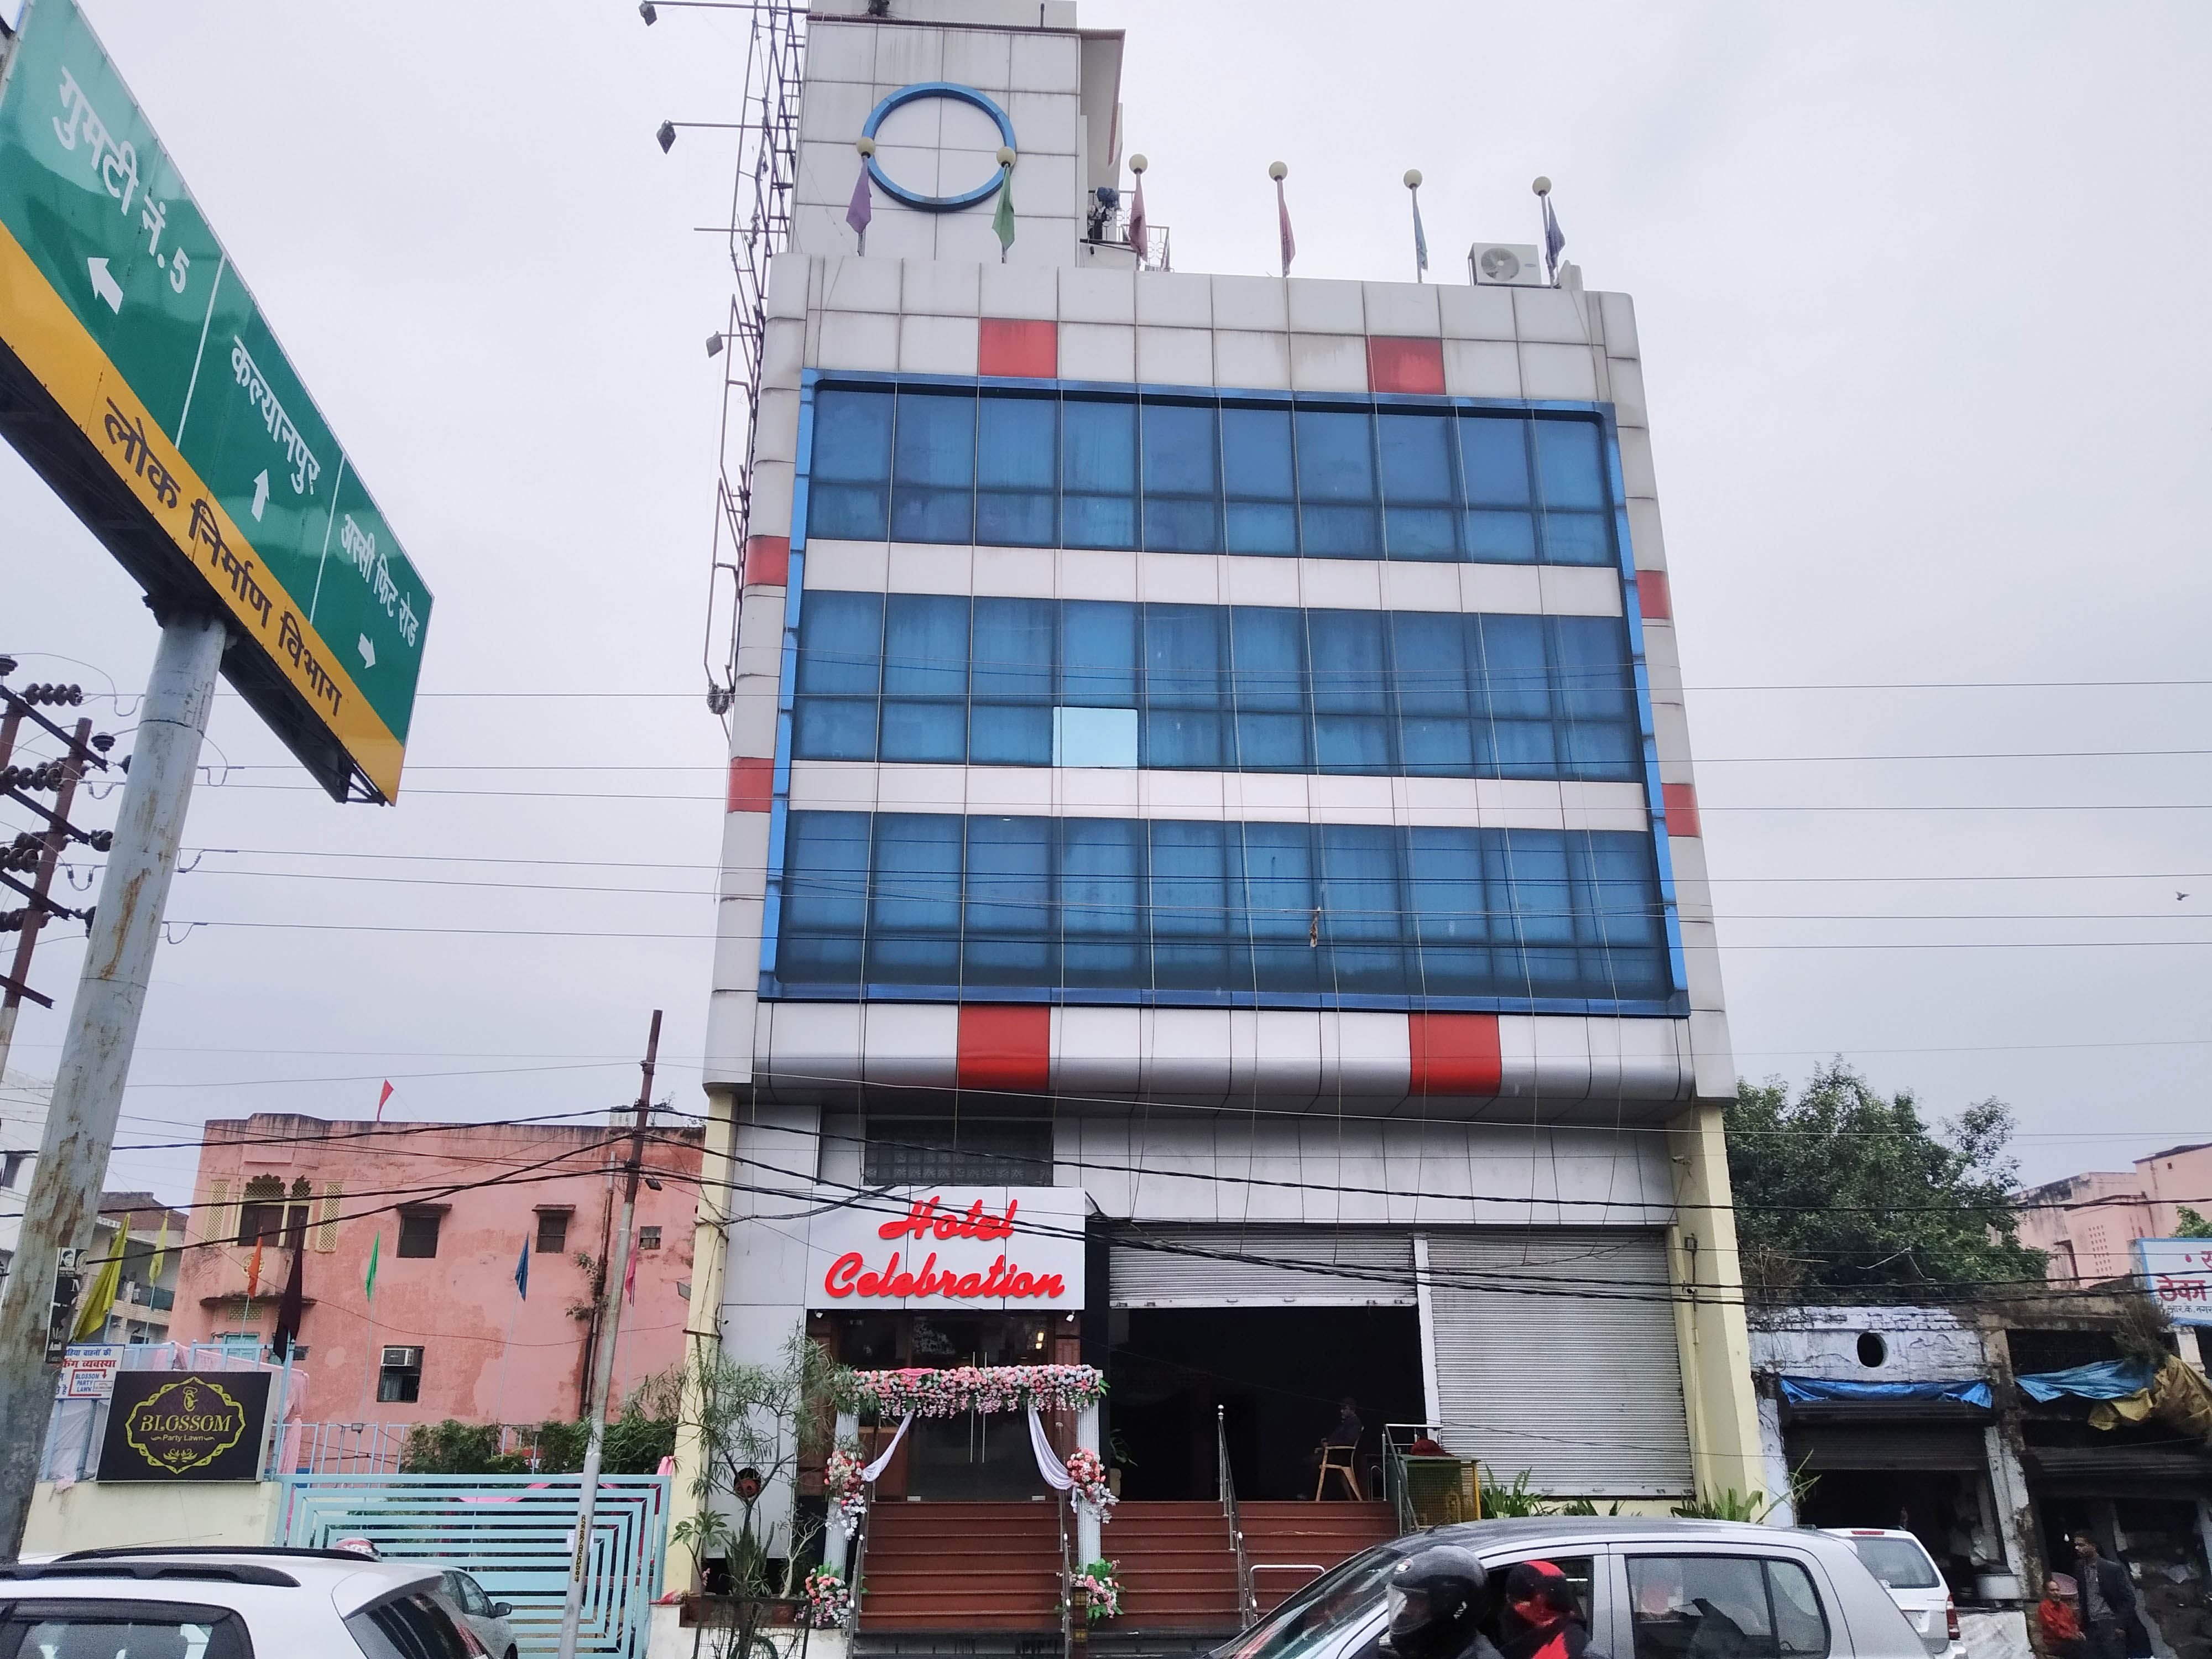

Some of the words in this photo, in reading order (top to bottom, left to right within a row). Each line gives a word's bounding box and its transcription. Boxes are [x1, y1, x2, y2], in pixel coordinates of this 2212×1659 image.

[53, 65, 139, 216] गुमटी
[232, 335, 320, 495] कल्यानपुर
[105, 397, 181, 509] लोक
[189, 498, 273, 629] निर्माण
[278, 610, 342, 717] विभाग
[341, 514, 375, 583] अस्सी
[373, 553, 398, 617] फिट
[399, 591, 419, 647] रोड
[825, 1251, 1066, 1298] Celebration
[878, 1195, 1018, 1240] Hotel
[139, 1415, 232, 1432] BLOSSOM
